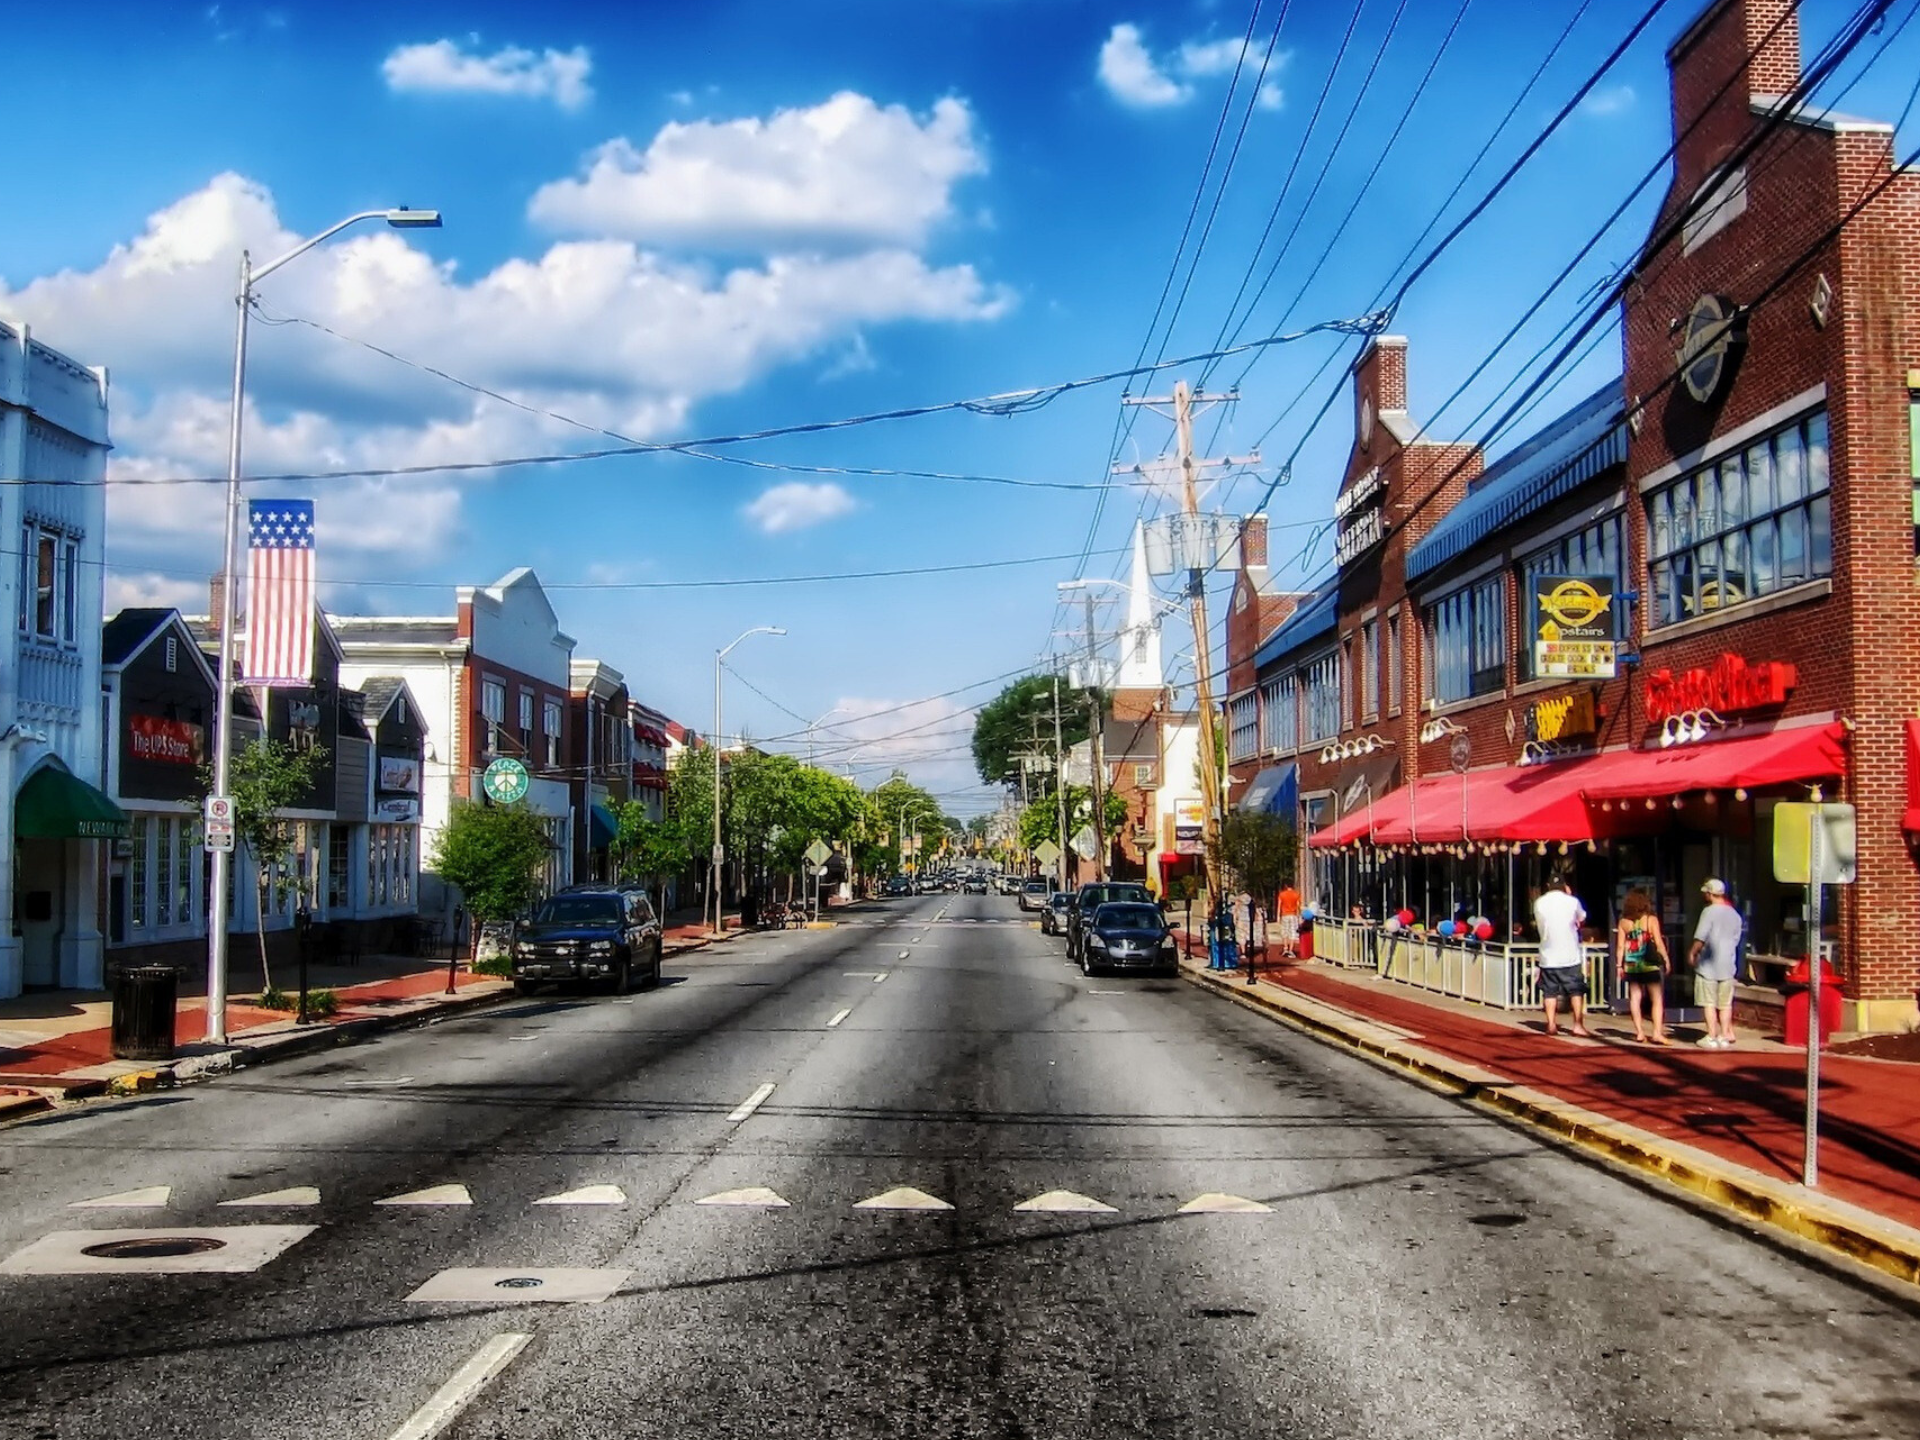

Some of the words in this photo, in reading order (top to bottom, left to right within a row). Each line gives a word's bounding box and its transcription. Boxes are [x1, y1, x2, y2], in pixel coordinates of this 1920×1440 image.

[134, 731, 149, 752] The
[151, 734, 167, 755] UPS
[168, 736, 189, 757] Store
